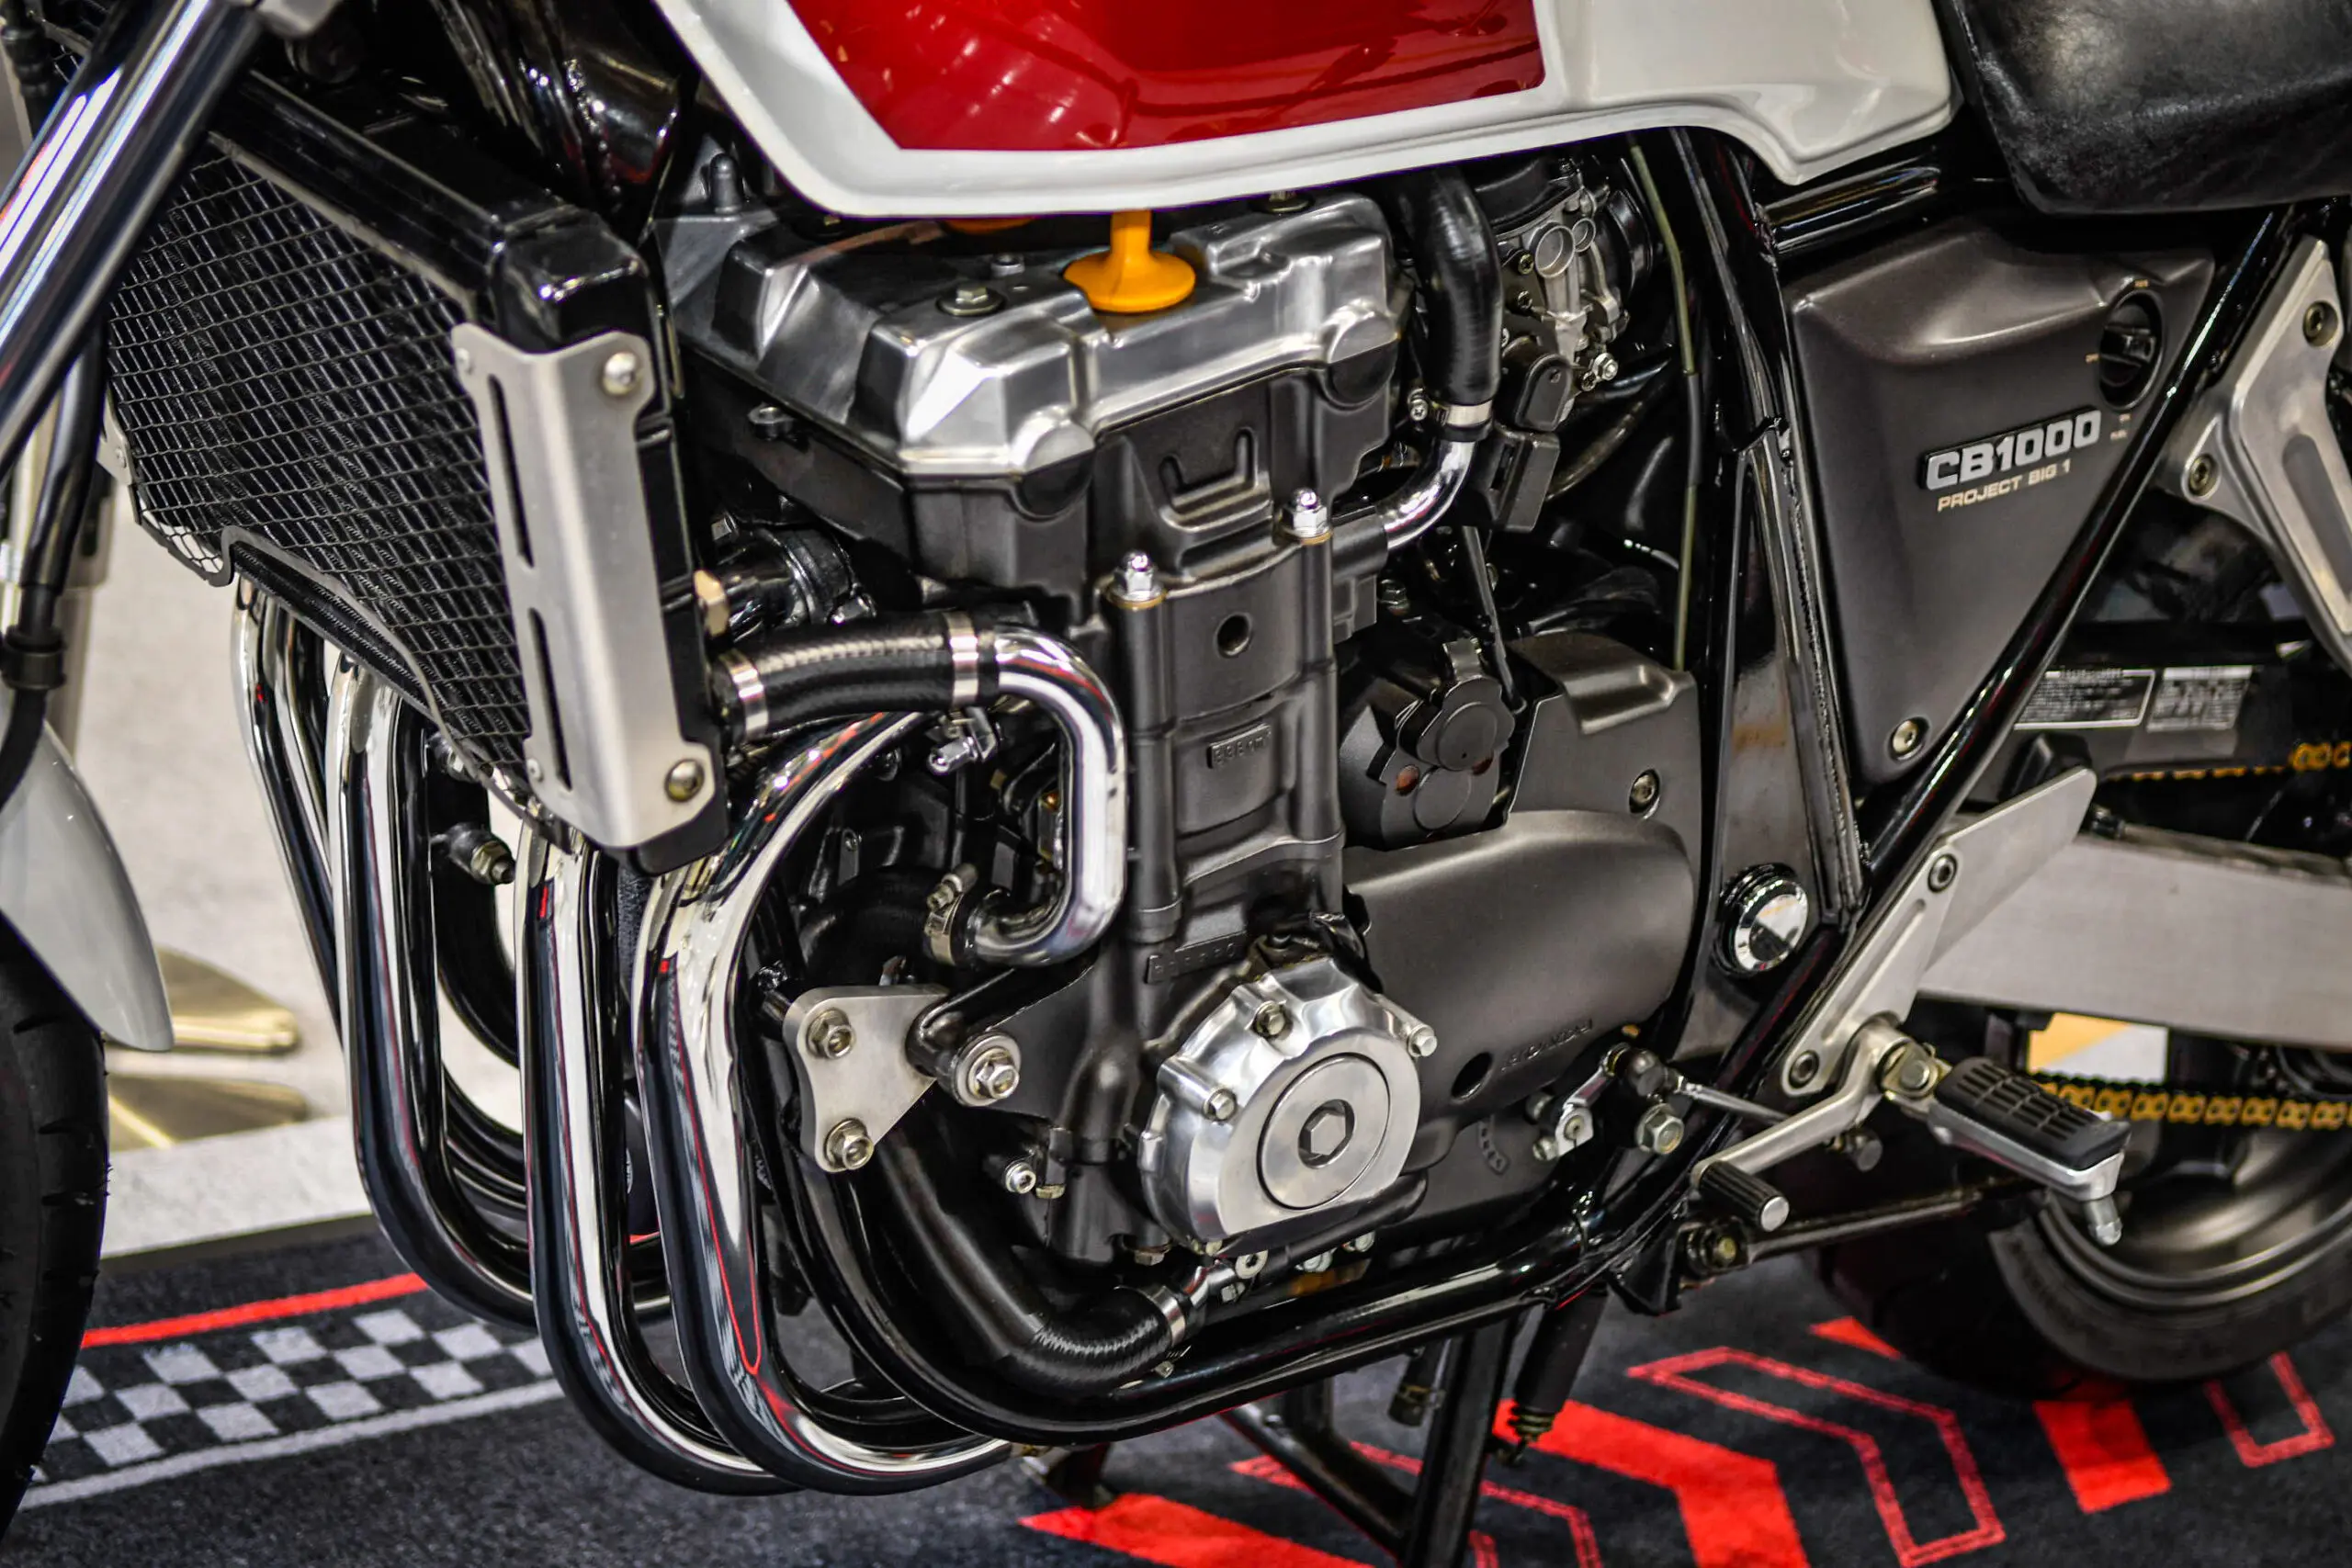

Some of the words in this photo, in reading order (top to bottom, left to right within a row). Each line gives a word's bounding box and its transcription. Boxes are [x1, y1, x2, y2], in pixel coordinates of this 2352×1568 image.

[1926, 410, 2102, 491] CB1000
[1937, 476, 2022, 513] PROJECT
[2028, 463, 2057, 487] BIG
[2061, 459, 2071, 474] 1
